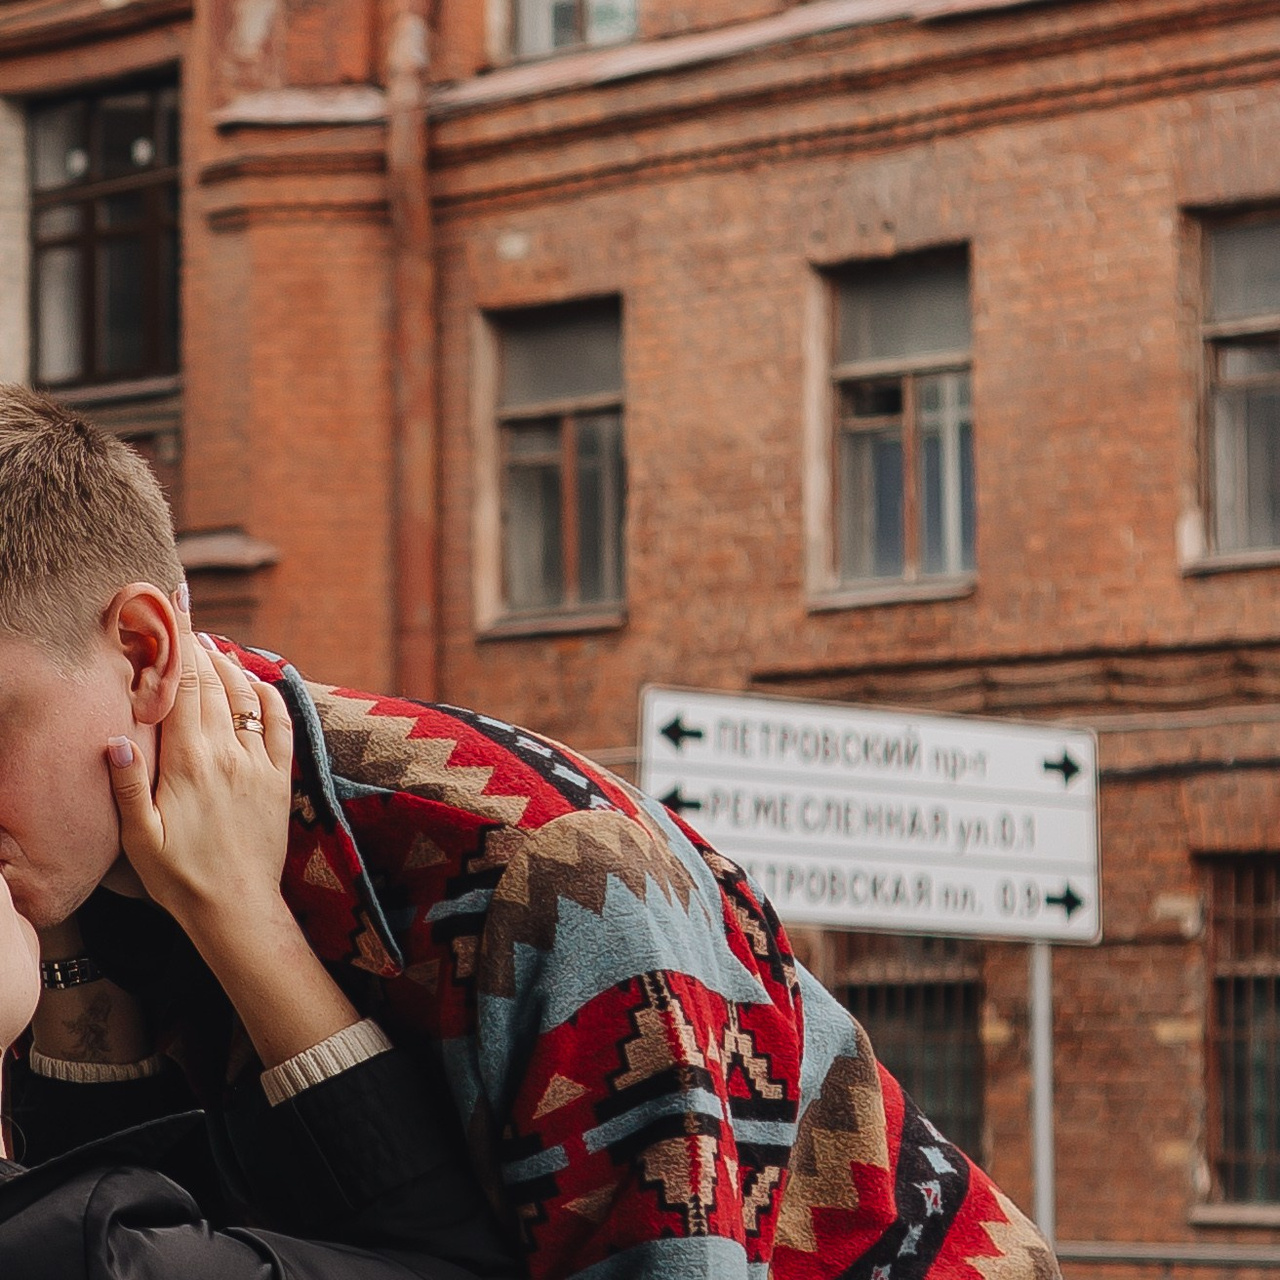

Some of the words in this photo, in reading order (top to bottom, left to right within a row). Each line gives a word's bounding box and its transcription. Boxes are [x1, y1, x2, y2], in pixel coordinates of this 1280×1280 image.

[716, 720, 920, 767] ПЕТРОВСКИЙ
[711, 790, 949, 842] РЕМЕСЛЕННАЯ
[746, 863, 932, 908] ТРОВСКАЯ
